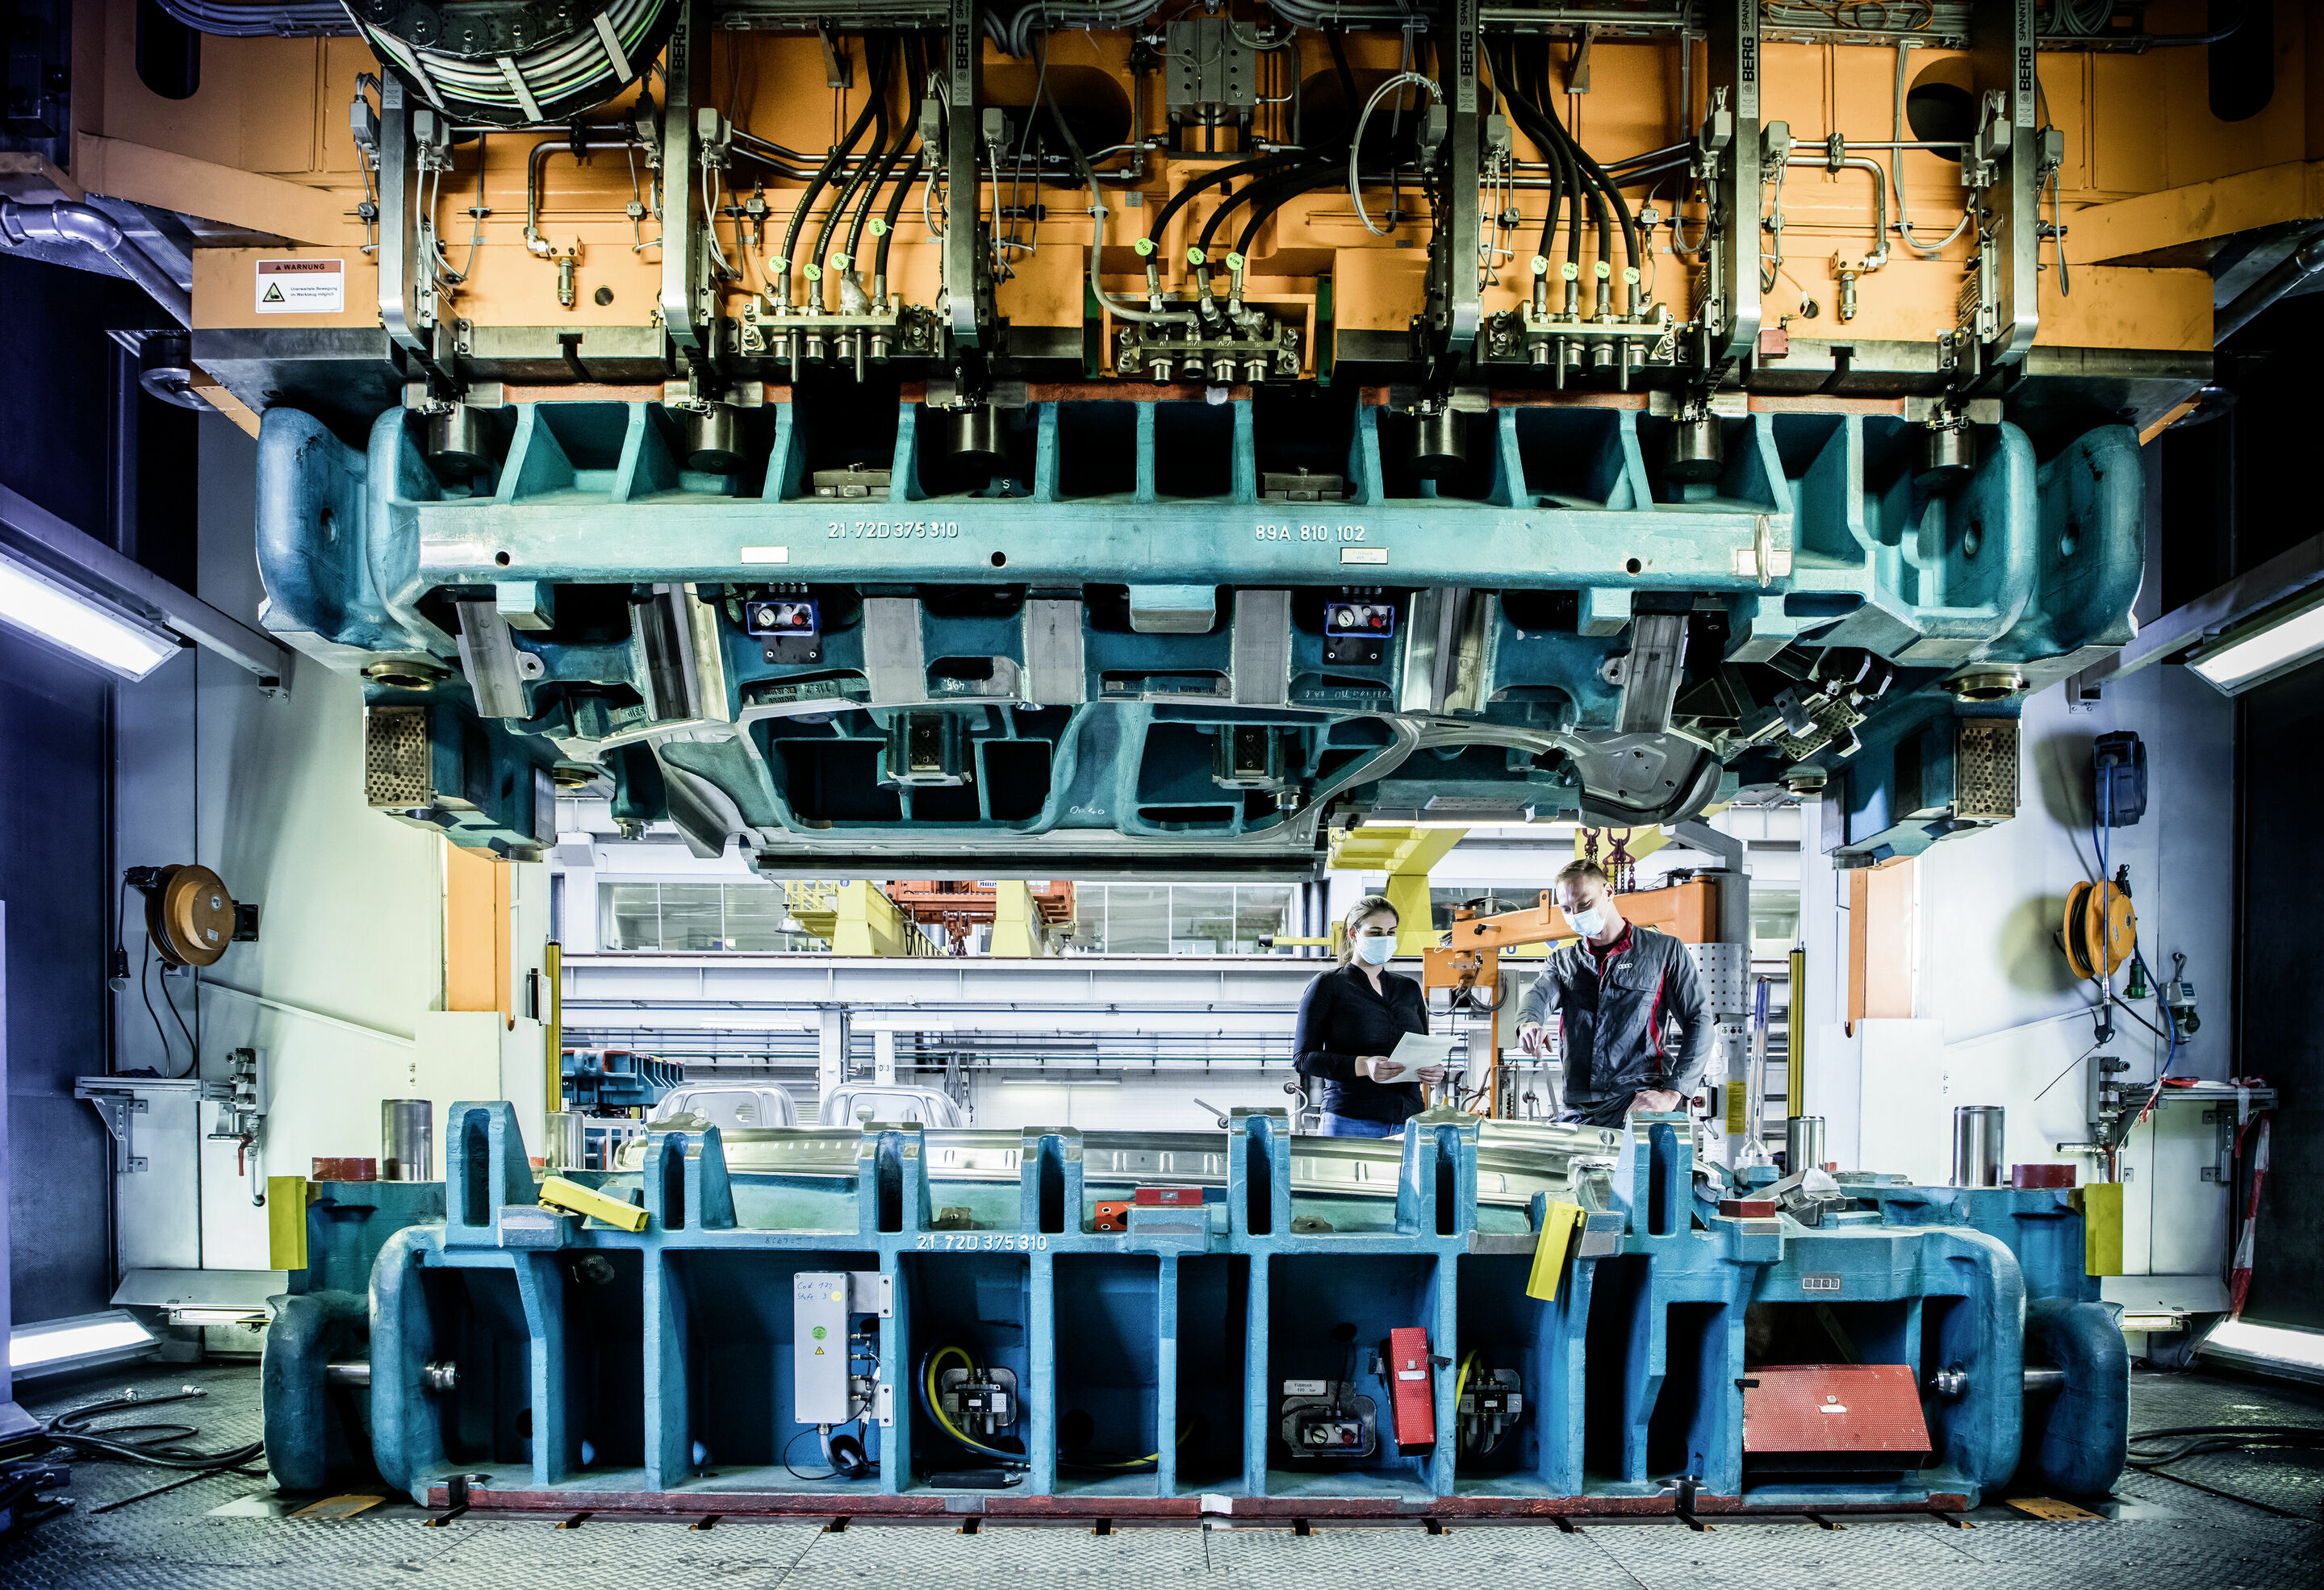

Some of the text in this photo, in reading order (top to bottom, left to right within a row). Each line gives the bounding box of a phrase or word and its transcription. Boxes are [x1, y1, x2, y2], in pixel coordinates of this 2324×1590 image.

[672, 24, 686, 69] BERG
[955, 24, 968, 69] BERG
[1460, 31, 1473, 76] BERG
[1742, 37, 1754, 81] BERG
[2019, 46, 2031, 91] BERG
[818, 227, 831, 254] HANSA-FLEX
[1139, 241, 1149, 251] 0127
[772, 260, 783, 269] 0123
[834, 256, 844, 266] 0125
[807, 267, 817, 277] 0124
[1002, 479, 1010, 489] S
[893, 522, 926, 539] 375
[930, 521, 959, 539] 310
[917, 1234, 1047, 1250] 21 72D 375 310
[818, 1282, 833, 1290] 172
